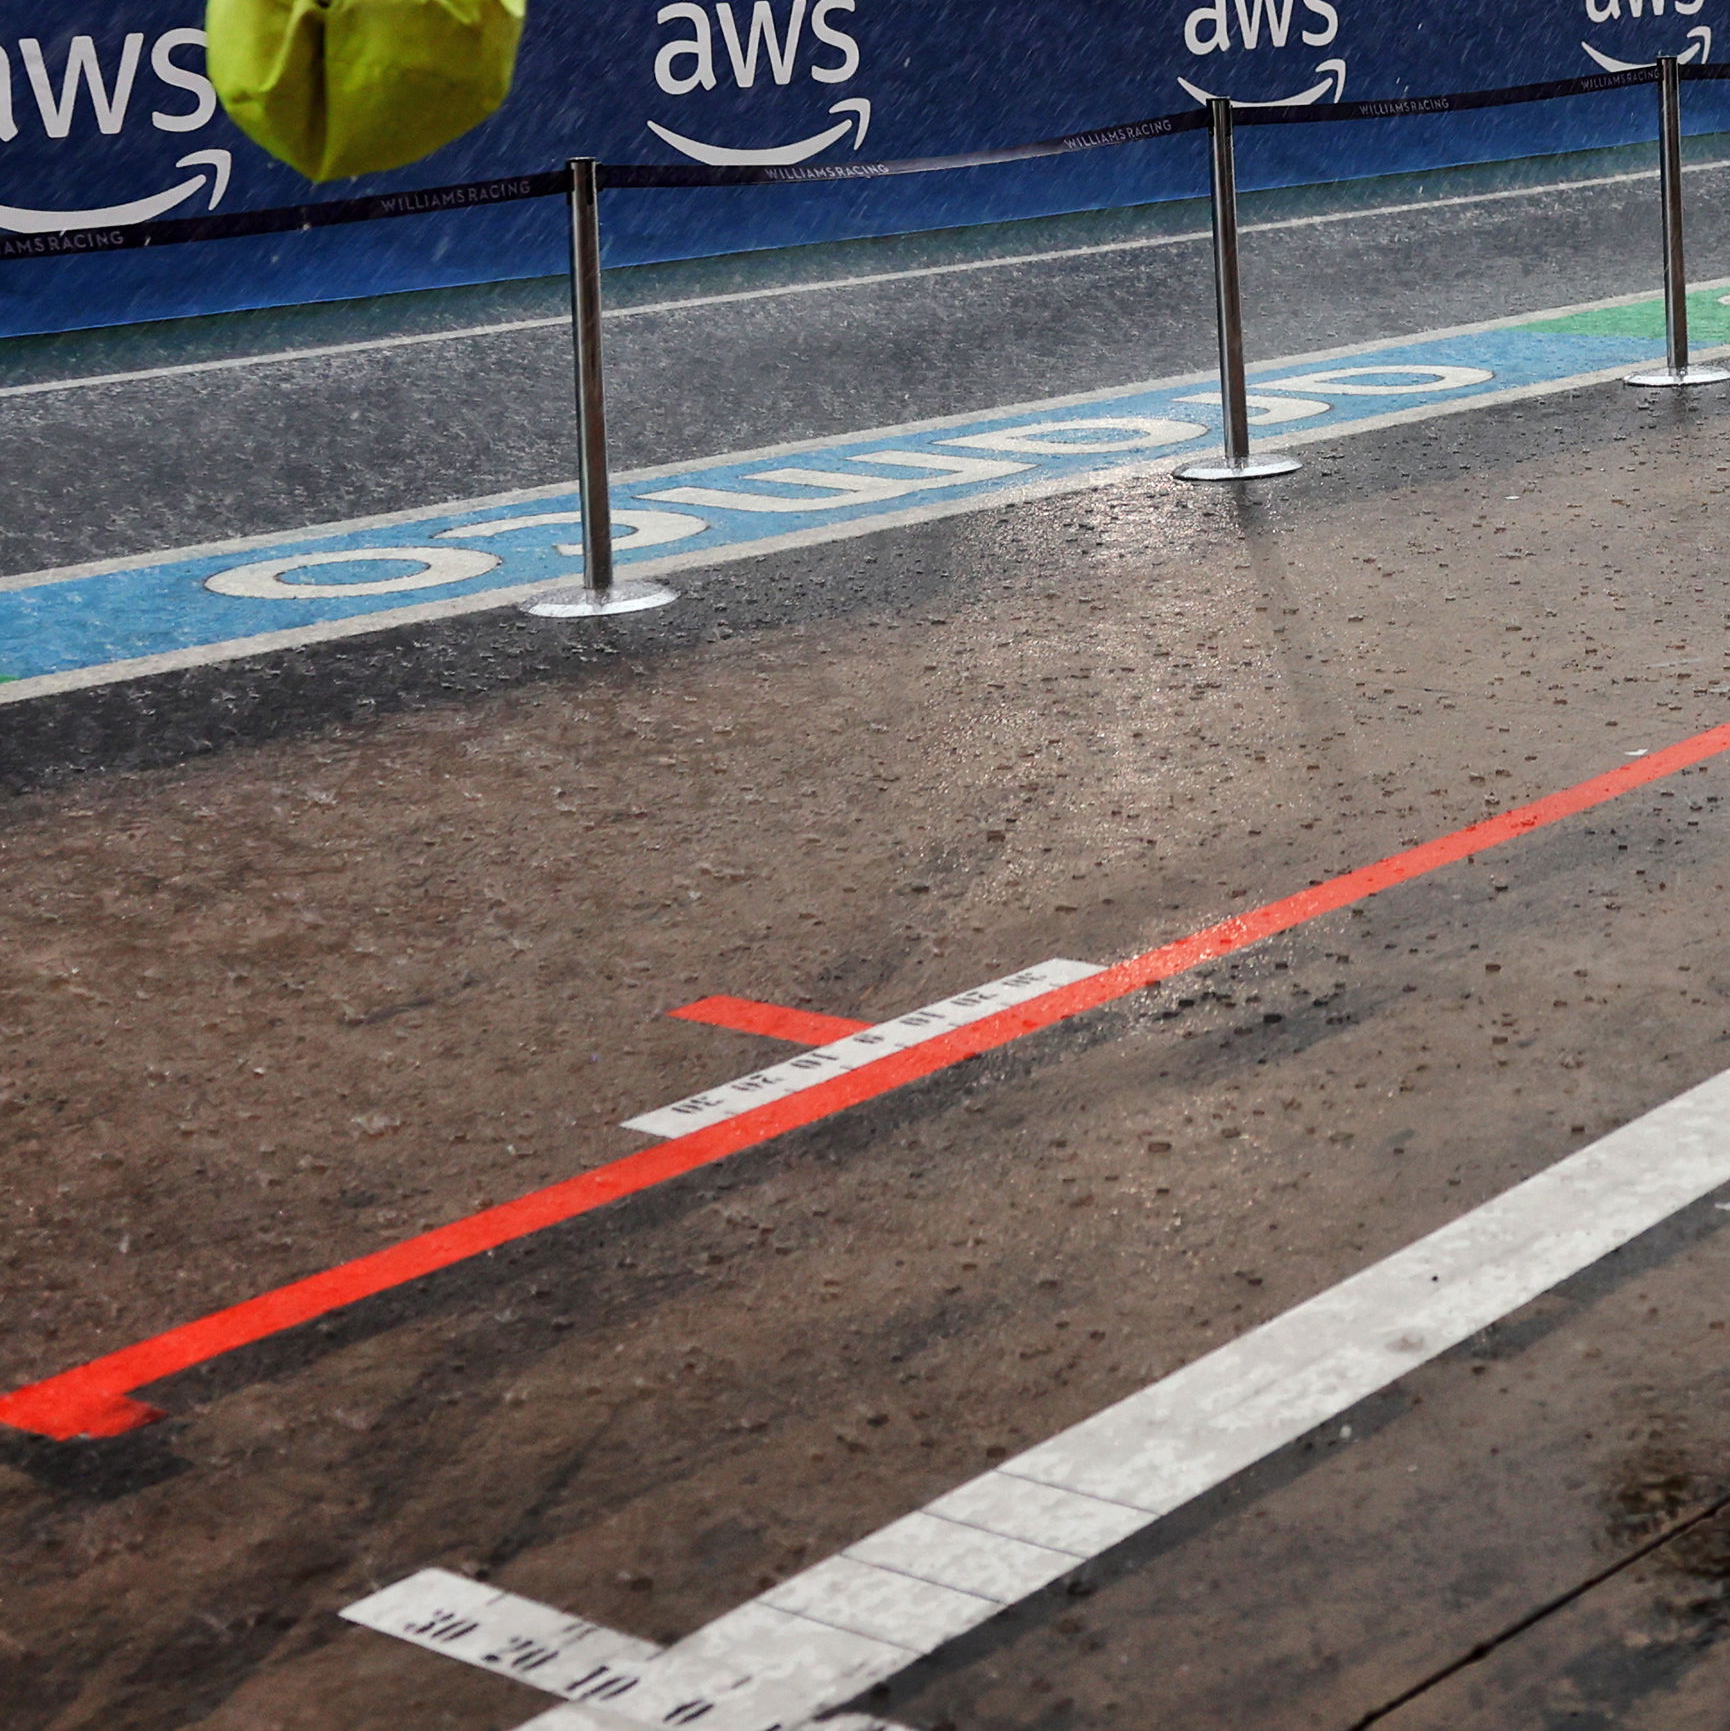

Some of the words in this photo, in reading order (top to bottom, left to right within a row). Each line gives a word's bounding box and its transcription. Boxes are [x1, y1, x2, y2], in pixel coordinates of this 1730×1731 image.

[0, 27, 216, 142] ws
[404, 1609, 479, 1642] 30
[481, 1636, 559, 1670] 20
[566, 1665, 641, 1703] 10
[662, 1700, 716, 1726] 0
